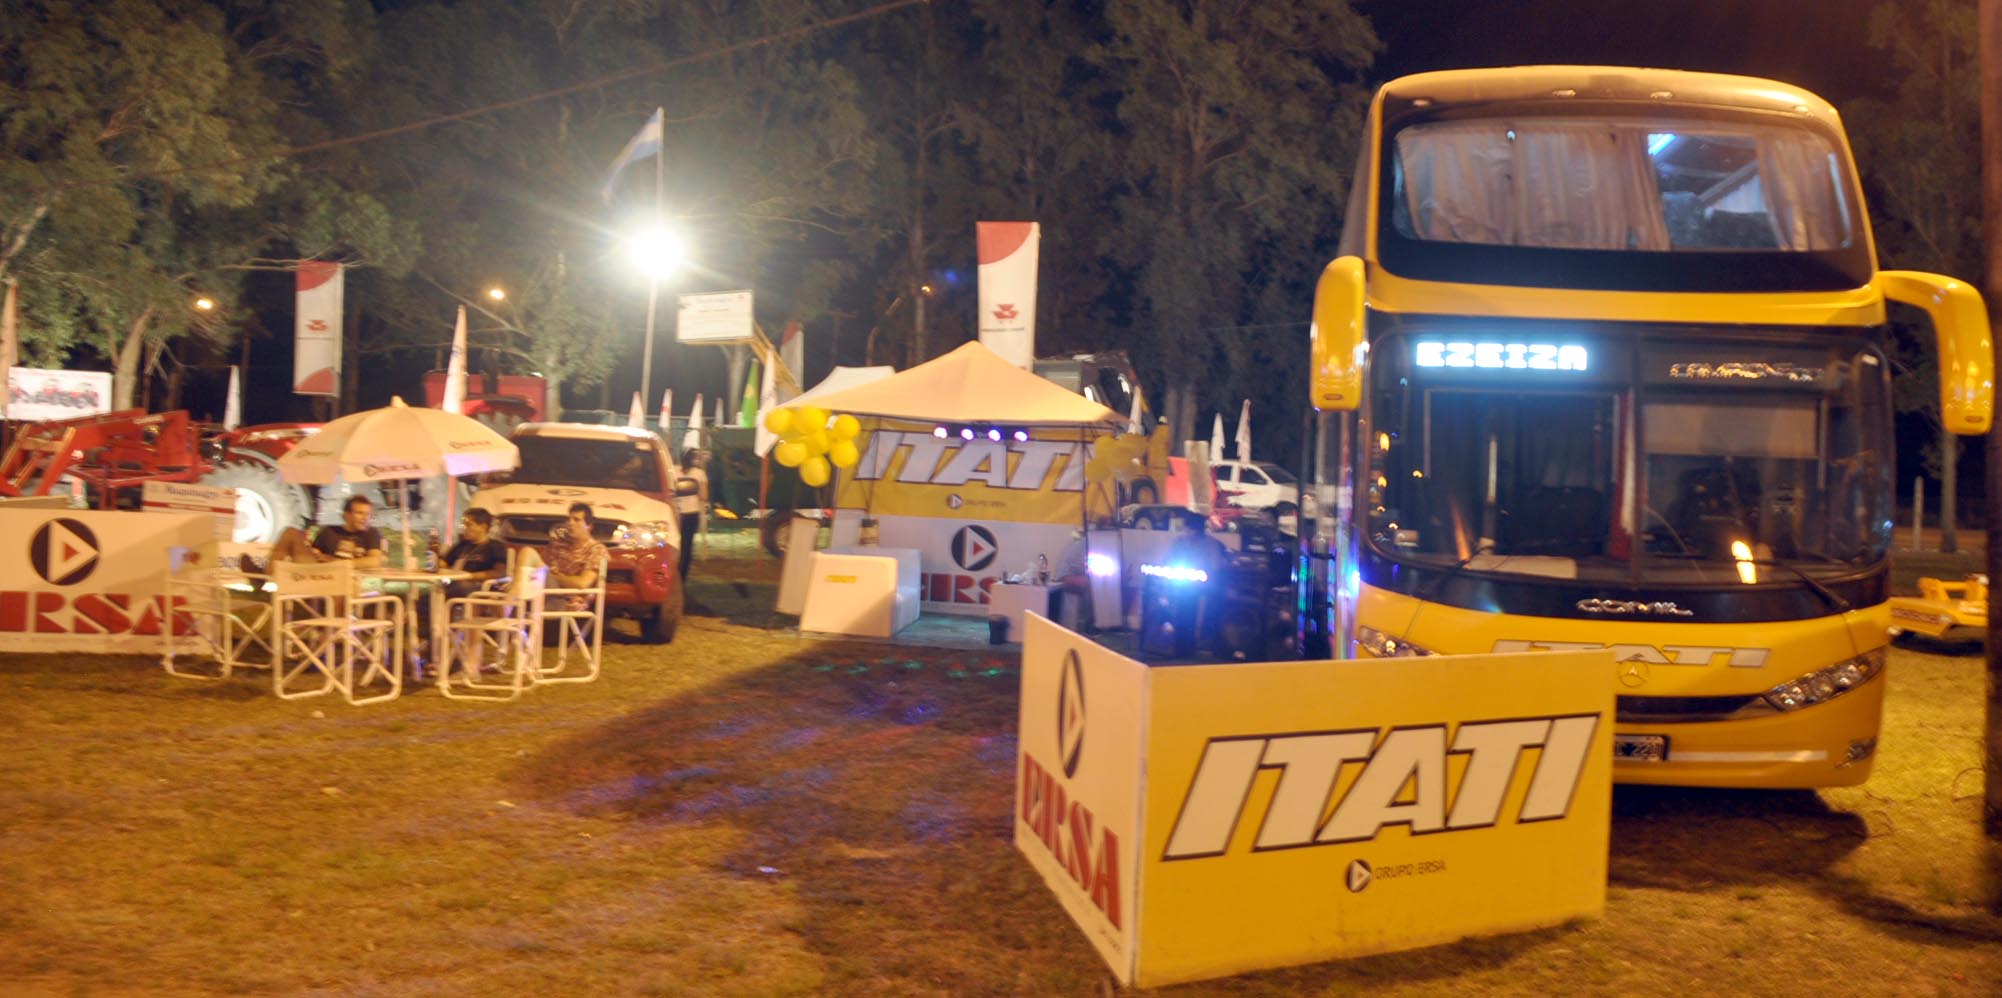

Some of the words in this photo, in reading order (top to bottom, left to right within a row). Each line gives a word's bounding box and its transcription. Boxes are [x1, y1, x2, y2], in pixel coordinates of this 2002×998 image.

[1416, 342, 1588, 371] EZEIZA
[853, 430, 1096, 492] ITATI
[0, 591, 200, 637] RSA
[1160, 711, 1602, 862] ITATI
[1022, 751, 1122, 932] ERSA
[1417, 860, 1447, 874] ERSA
